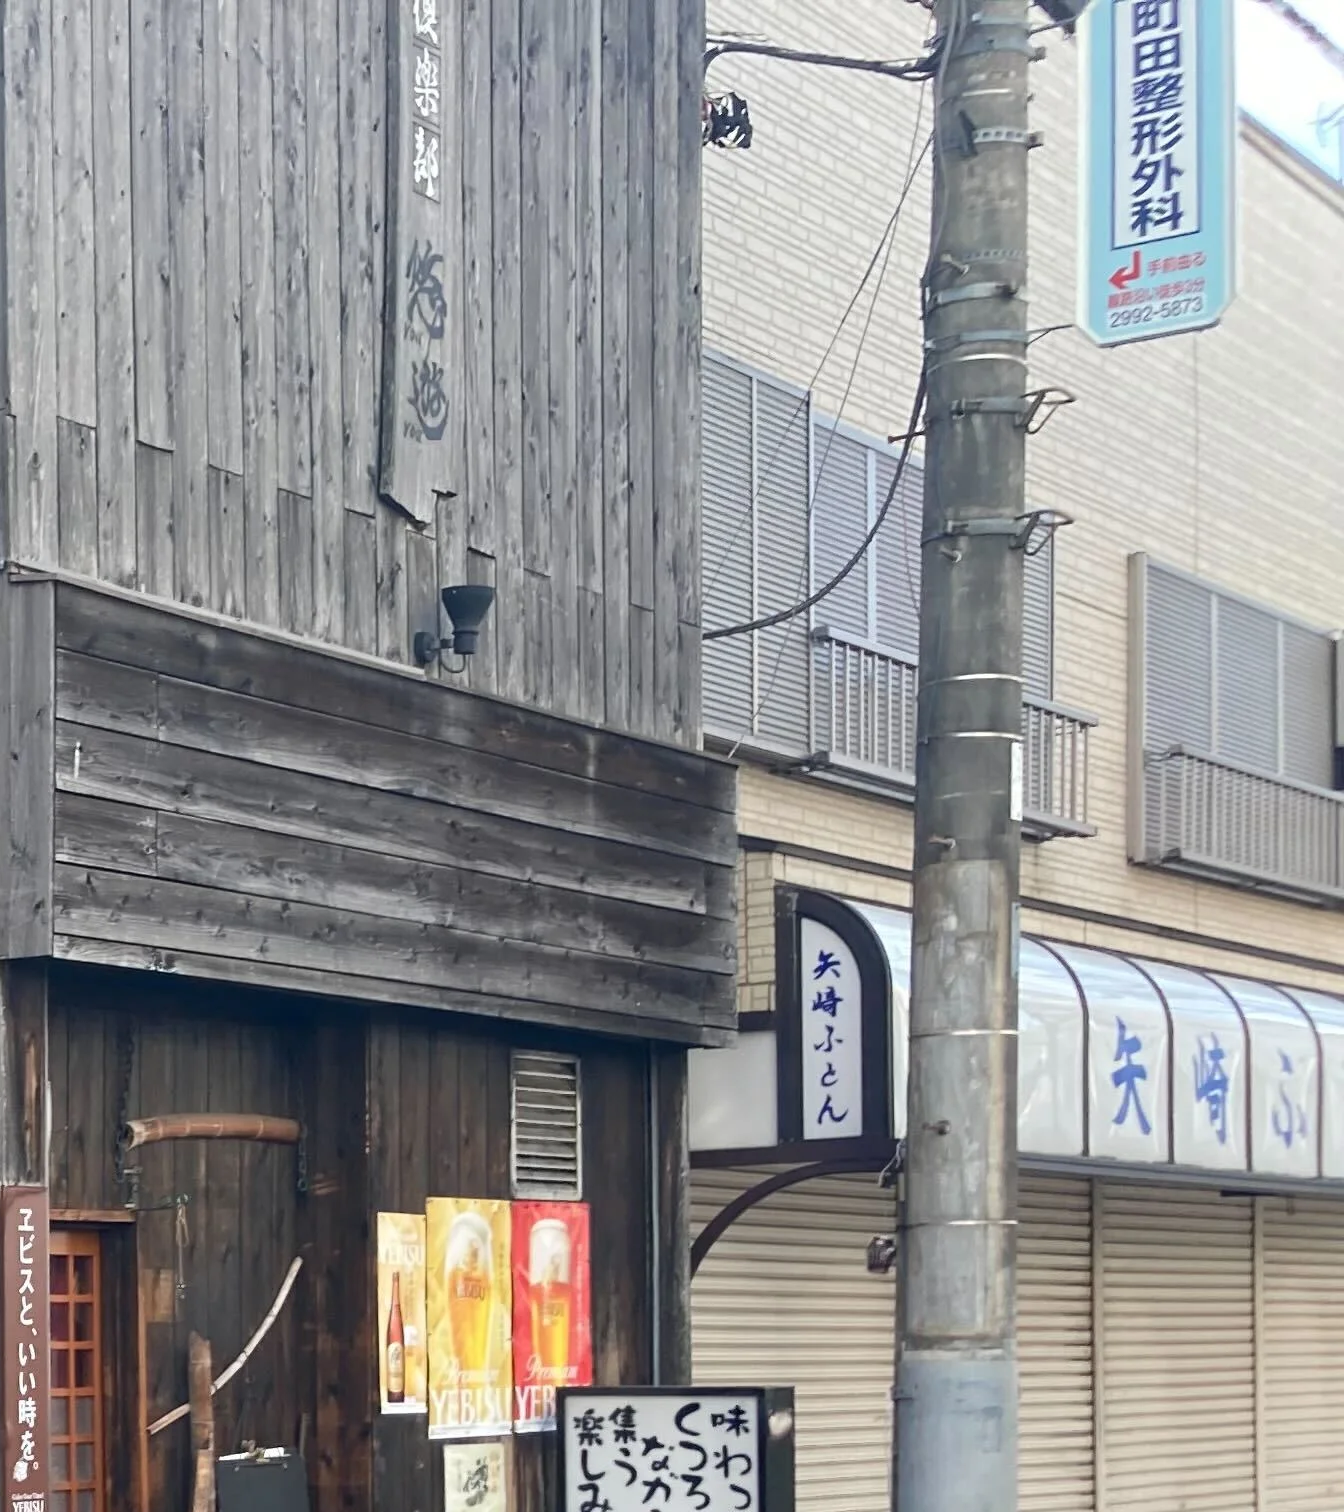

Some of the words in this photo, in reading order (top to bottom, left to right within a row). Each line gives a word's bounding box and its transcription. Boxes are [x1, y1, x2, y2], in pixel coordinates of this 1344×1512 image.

[1130, 0, 1184, 238] 町田整形外科
